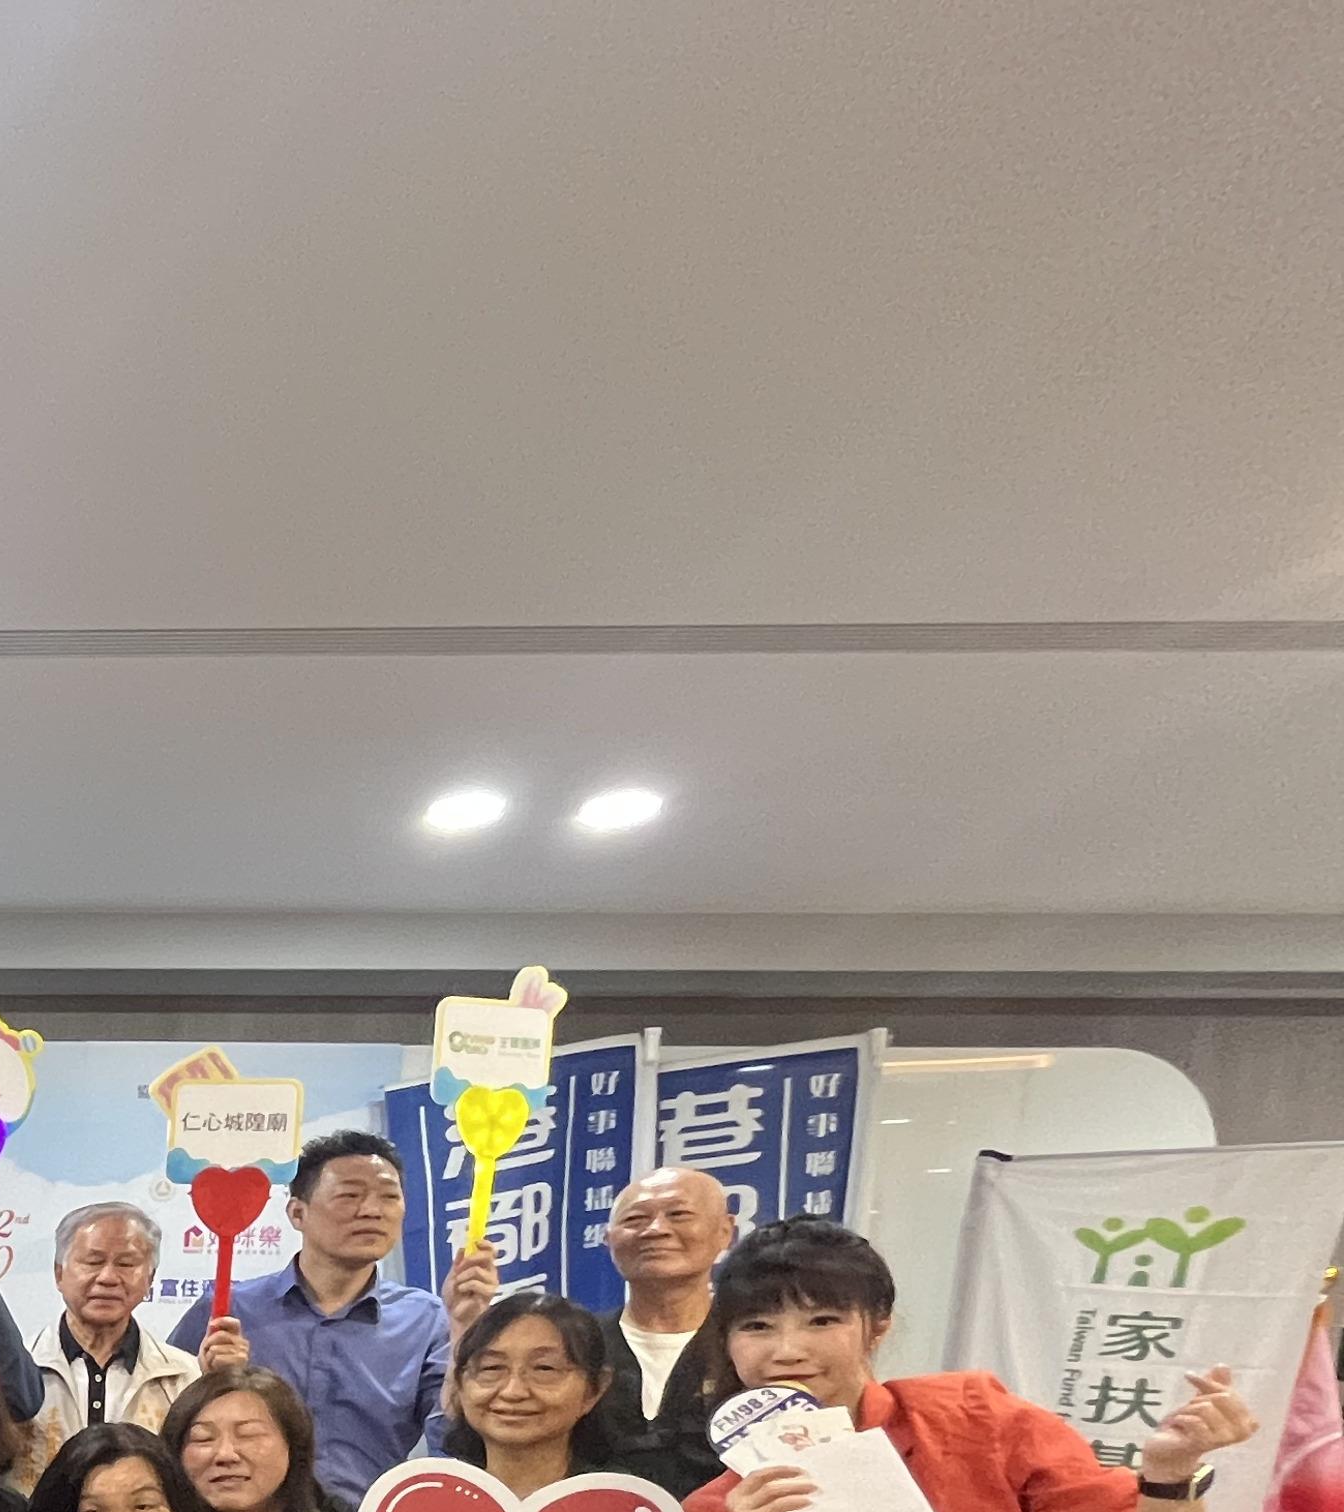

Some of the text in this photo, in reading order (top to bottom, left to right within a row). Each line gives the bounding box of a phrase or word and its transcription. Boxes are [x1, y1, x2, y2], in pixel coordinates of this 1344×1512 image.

[181, 1111, 288, 1133] 仁心城隍廟
[1058, 1309, 1098, 1408] Taiwan Fund
